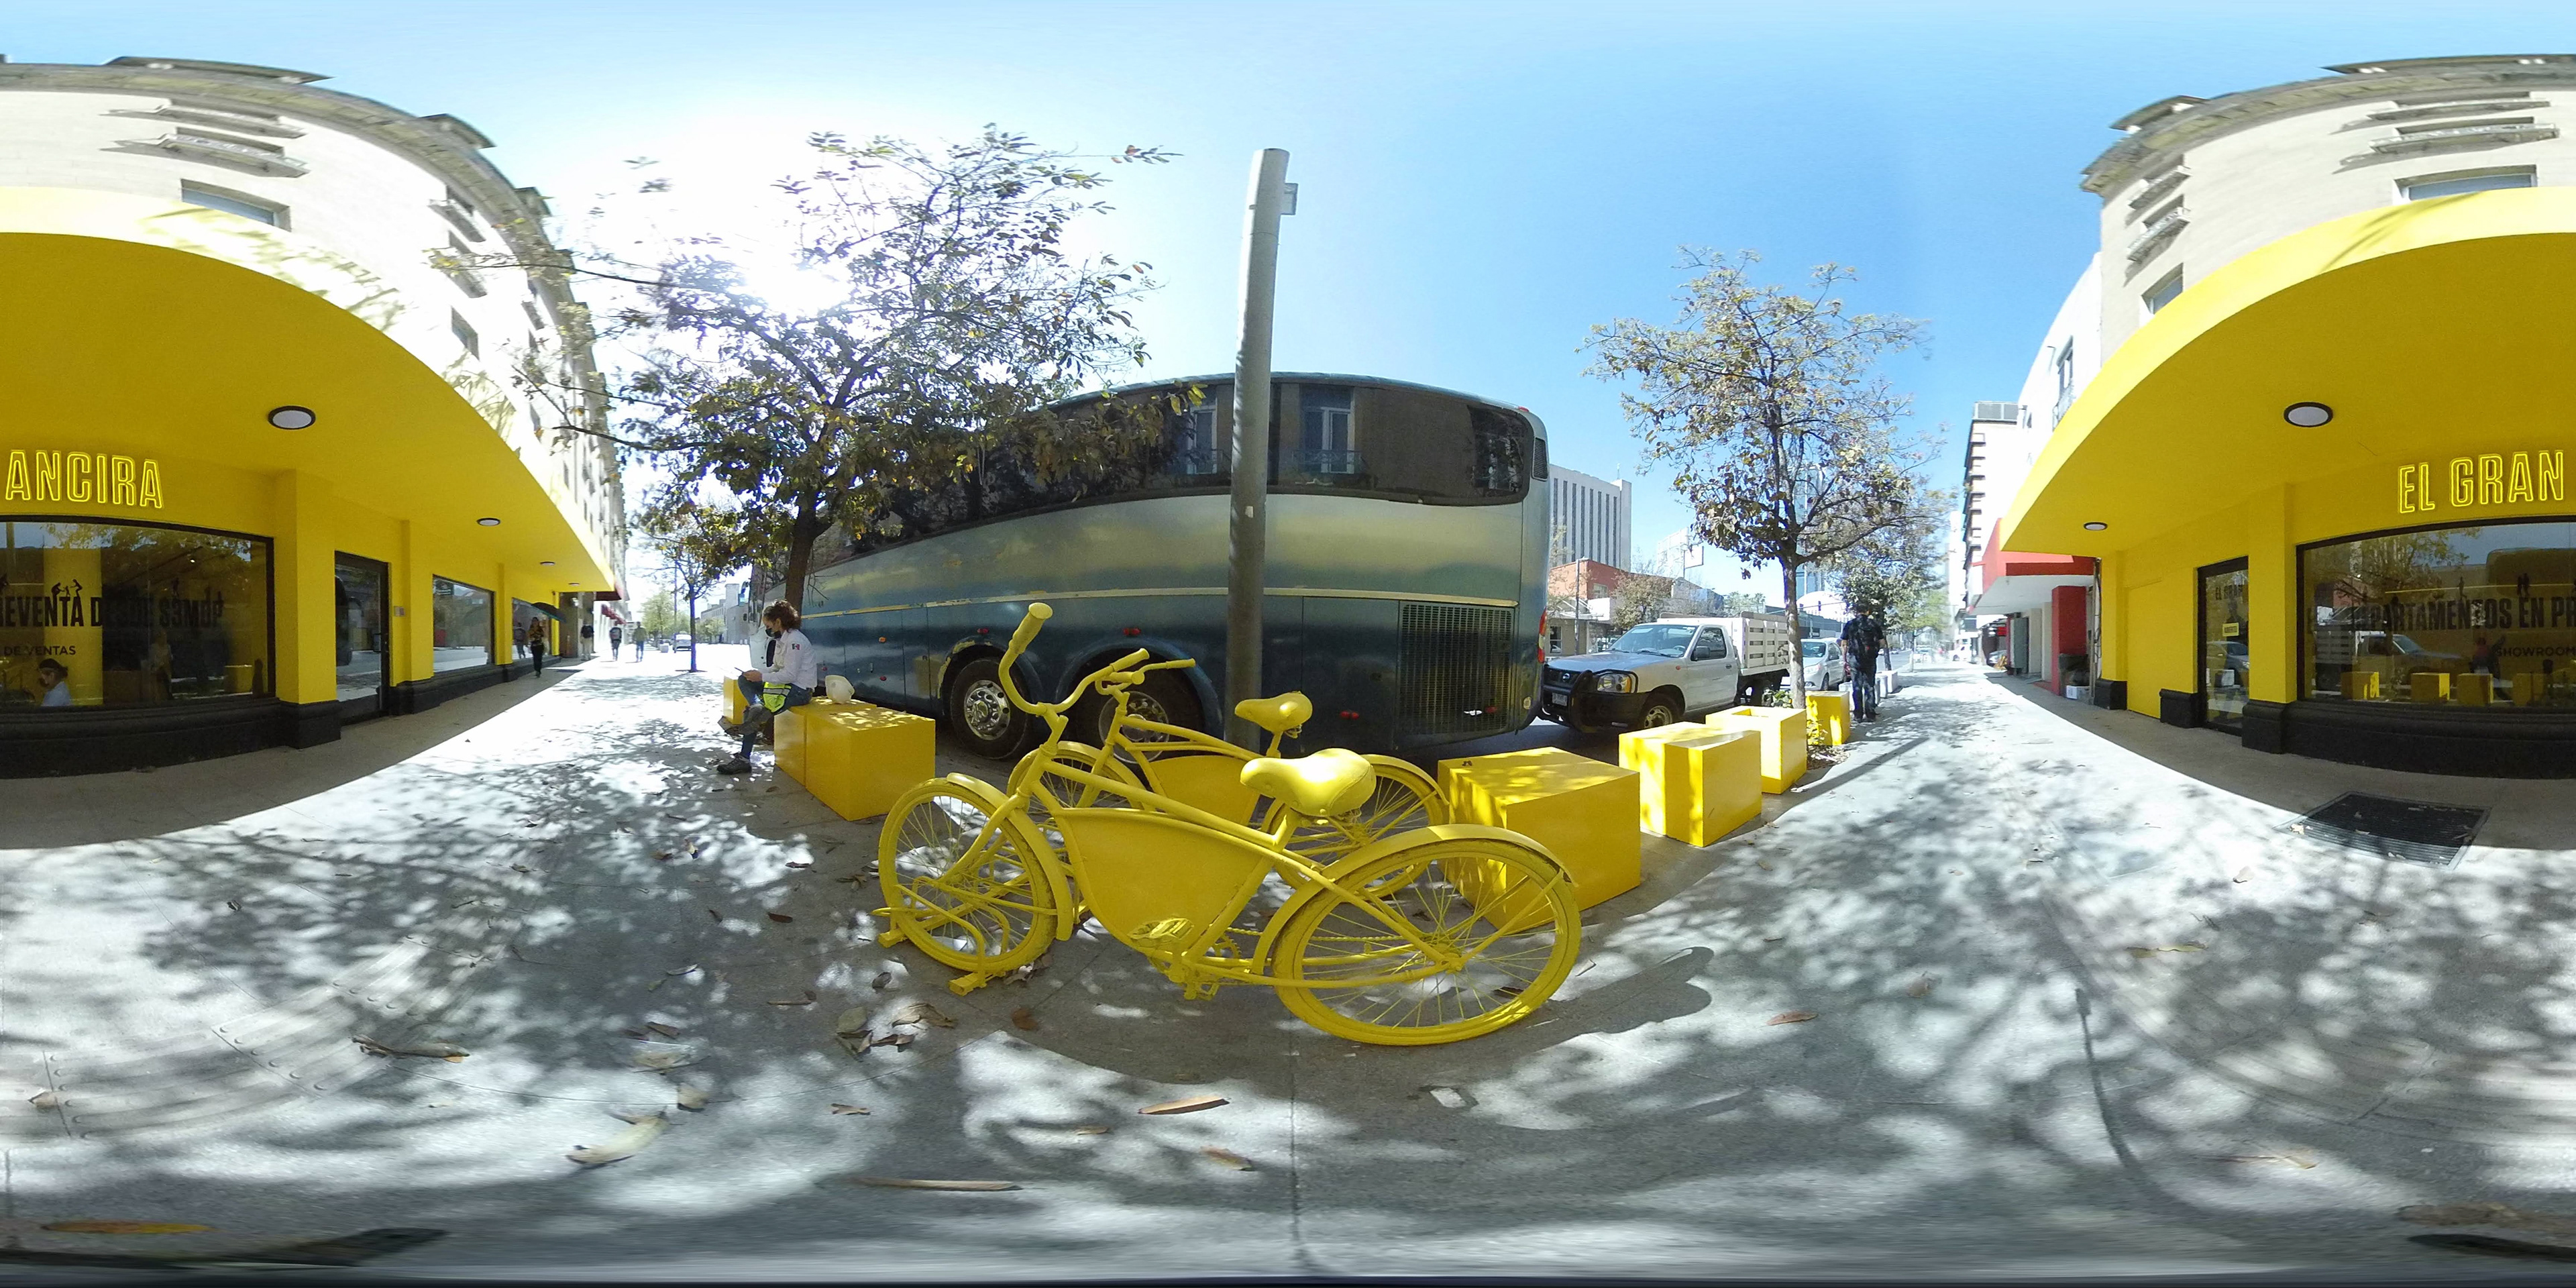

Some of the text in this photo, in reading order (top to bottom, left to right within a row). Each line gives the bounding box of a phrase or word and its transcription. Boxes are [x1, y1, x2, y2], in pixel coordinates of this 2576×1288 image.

[5, 449, 164, 509] ANCIRA
[2398, 450, 2565, 514] EL GRAN
[0, 596, 85, 627] EVENTA
[2518, 596, 2544, 629] EN
[3, 645, 76, 656] DE VENTAS
[2496, 646, 2576, 657] SHOWROOM
